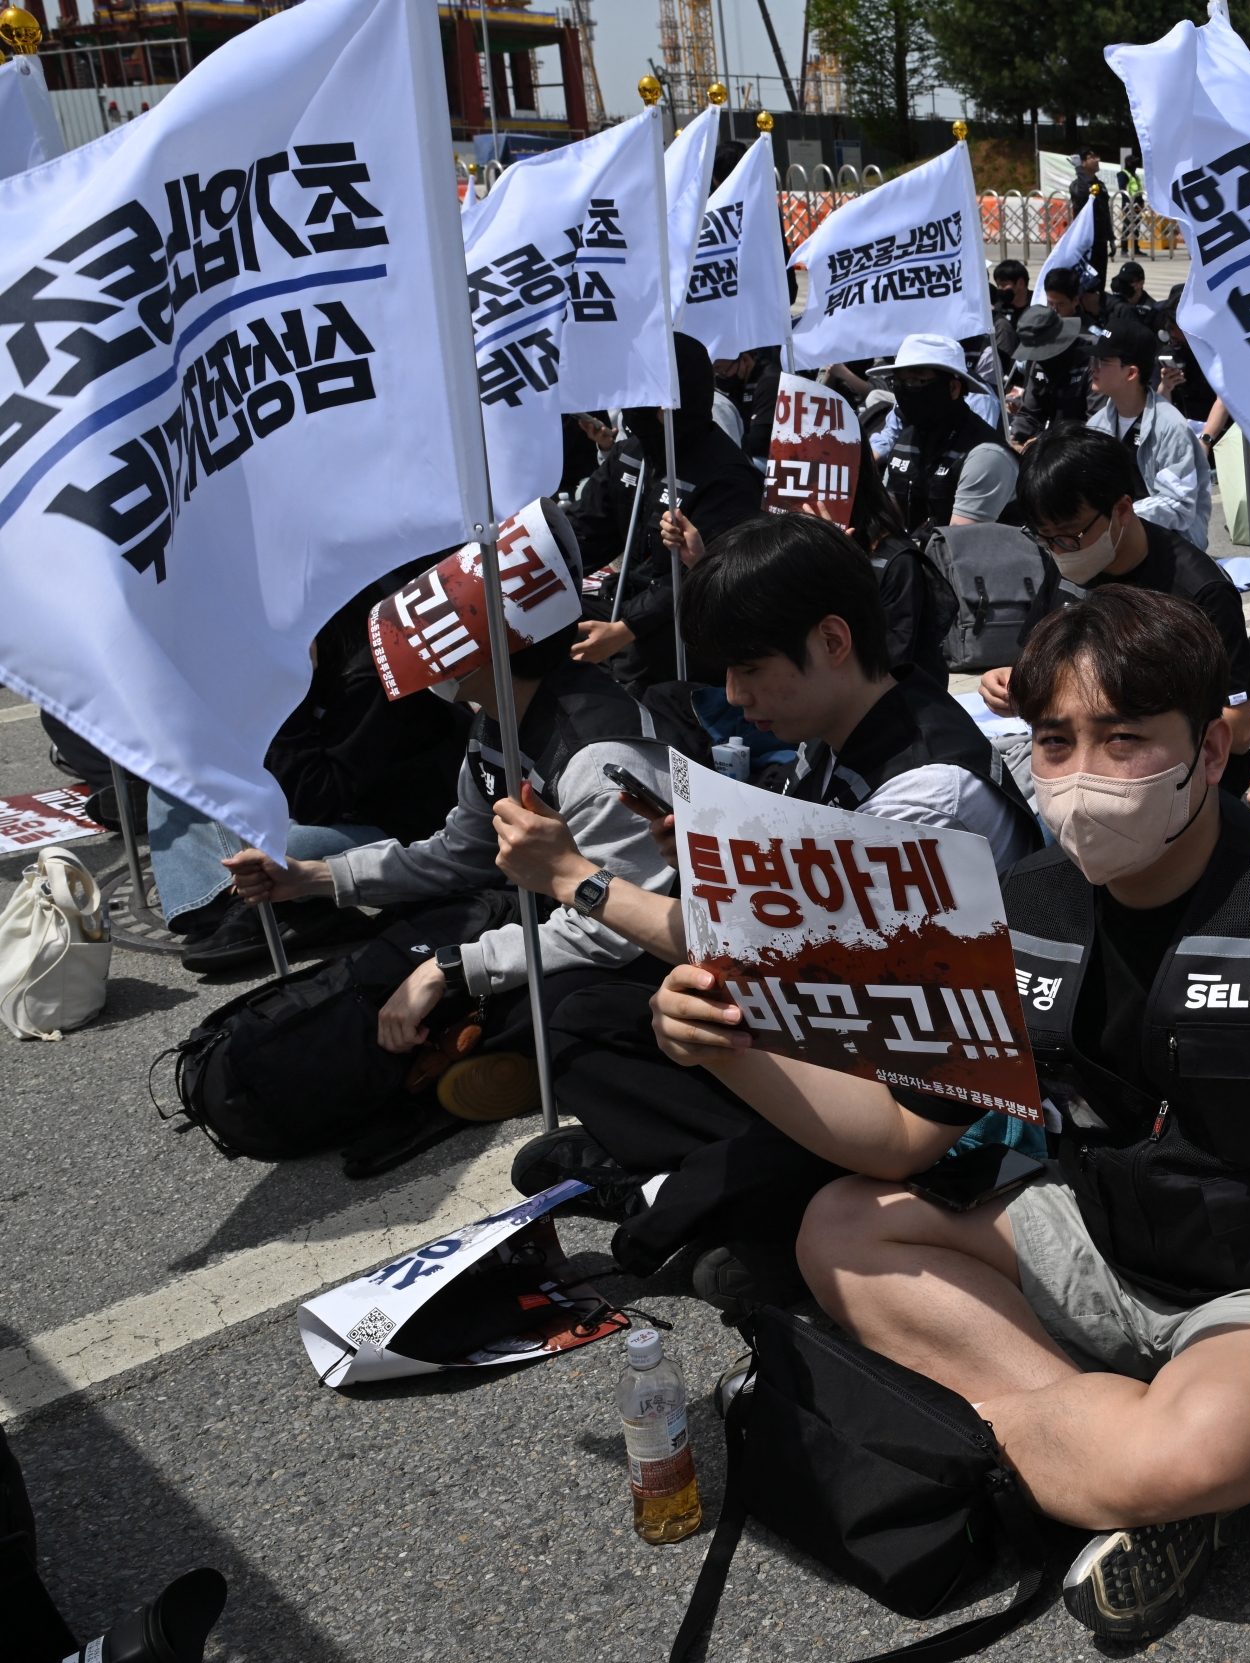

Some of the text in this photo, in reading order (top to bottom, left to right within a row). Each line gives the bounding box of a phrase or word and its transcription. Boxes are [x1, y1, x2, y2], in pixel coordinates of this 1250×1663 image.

[686, 830, 959, 930] 투명하게
[723, 975, 1022, 1064] 바꾸고!!!
[875, 1067, 1041, 1122] 삼성전자노동조합 공동투쟁본부
